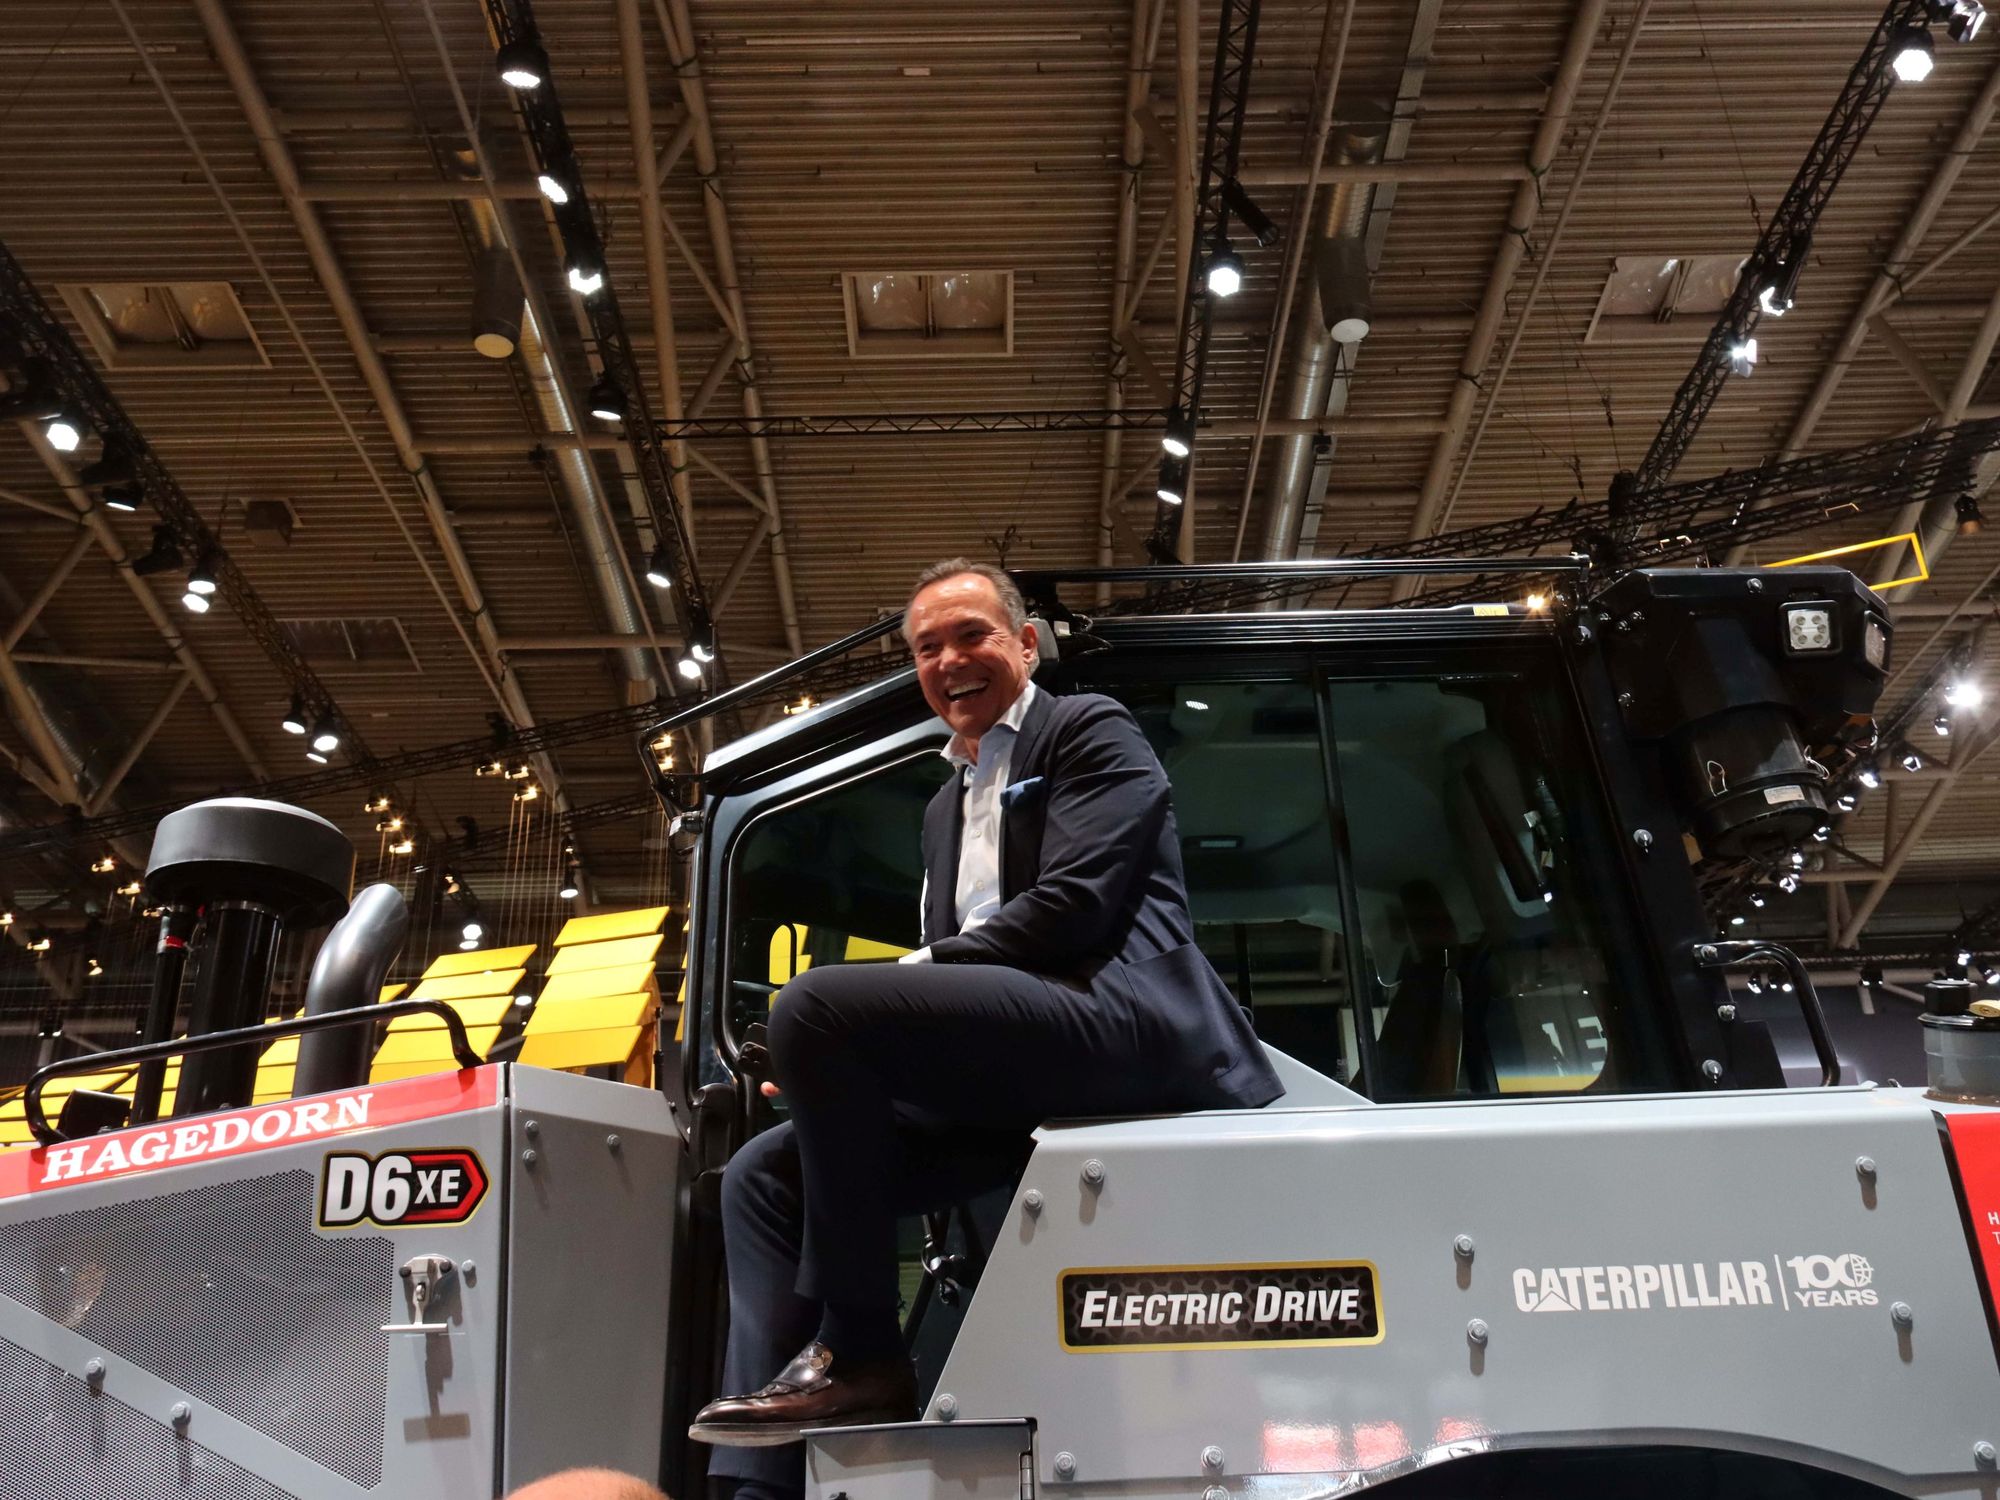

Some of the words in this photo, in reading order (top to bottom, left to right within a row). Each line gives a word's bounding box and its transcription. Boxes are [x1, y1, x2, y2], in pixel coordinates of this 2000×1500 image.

[41, 1092, 373, 1184] HAGEDORN
[1512, 1261, 1773, 1312] CATERPILLAR
[1786, 1253, 1874, 1288] 100
[1080, 1290, 1243, 1328] ELECTRIC
[1254, 1285, 1360, 1323] DRIVE
[1794, 1287, 1879, 1308] YEARS
